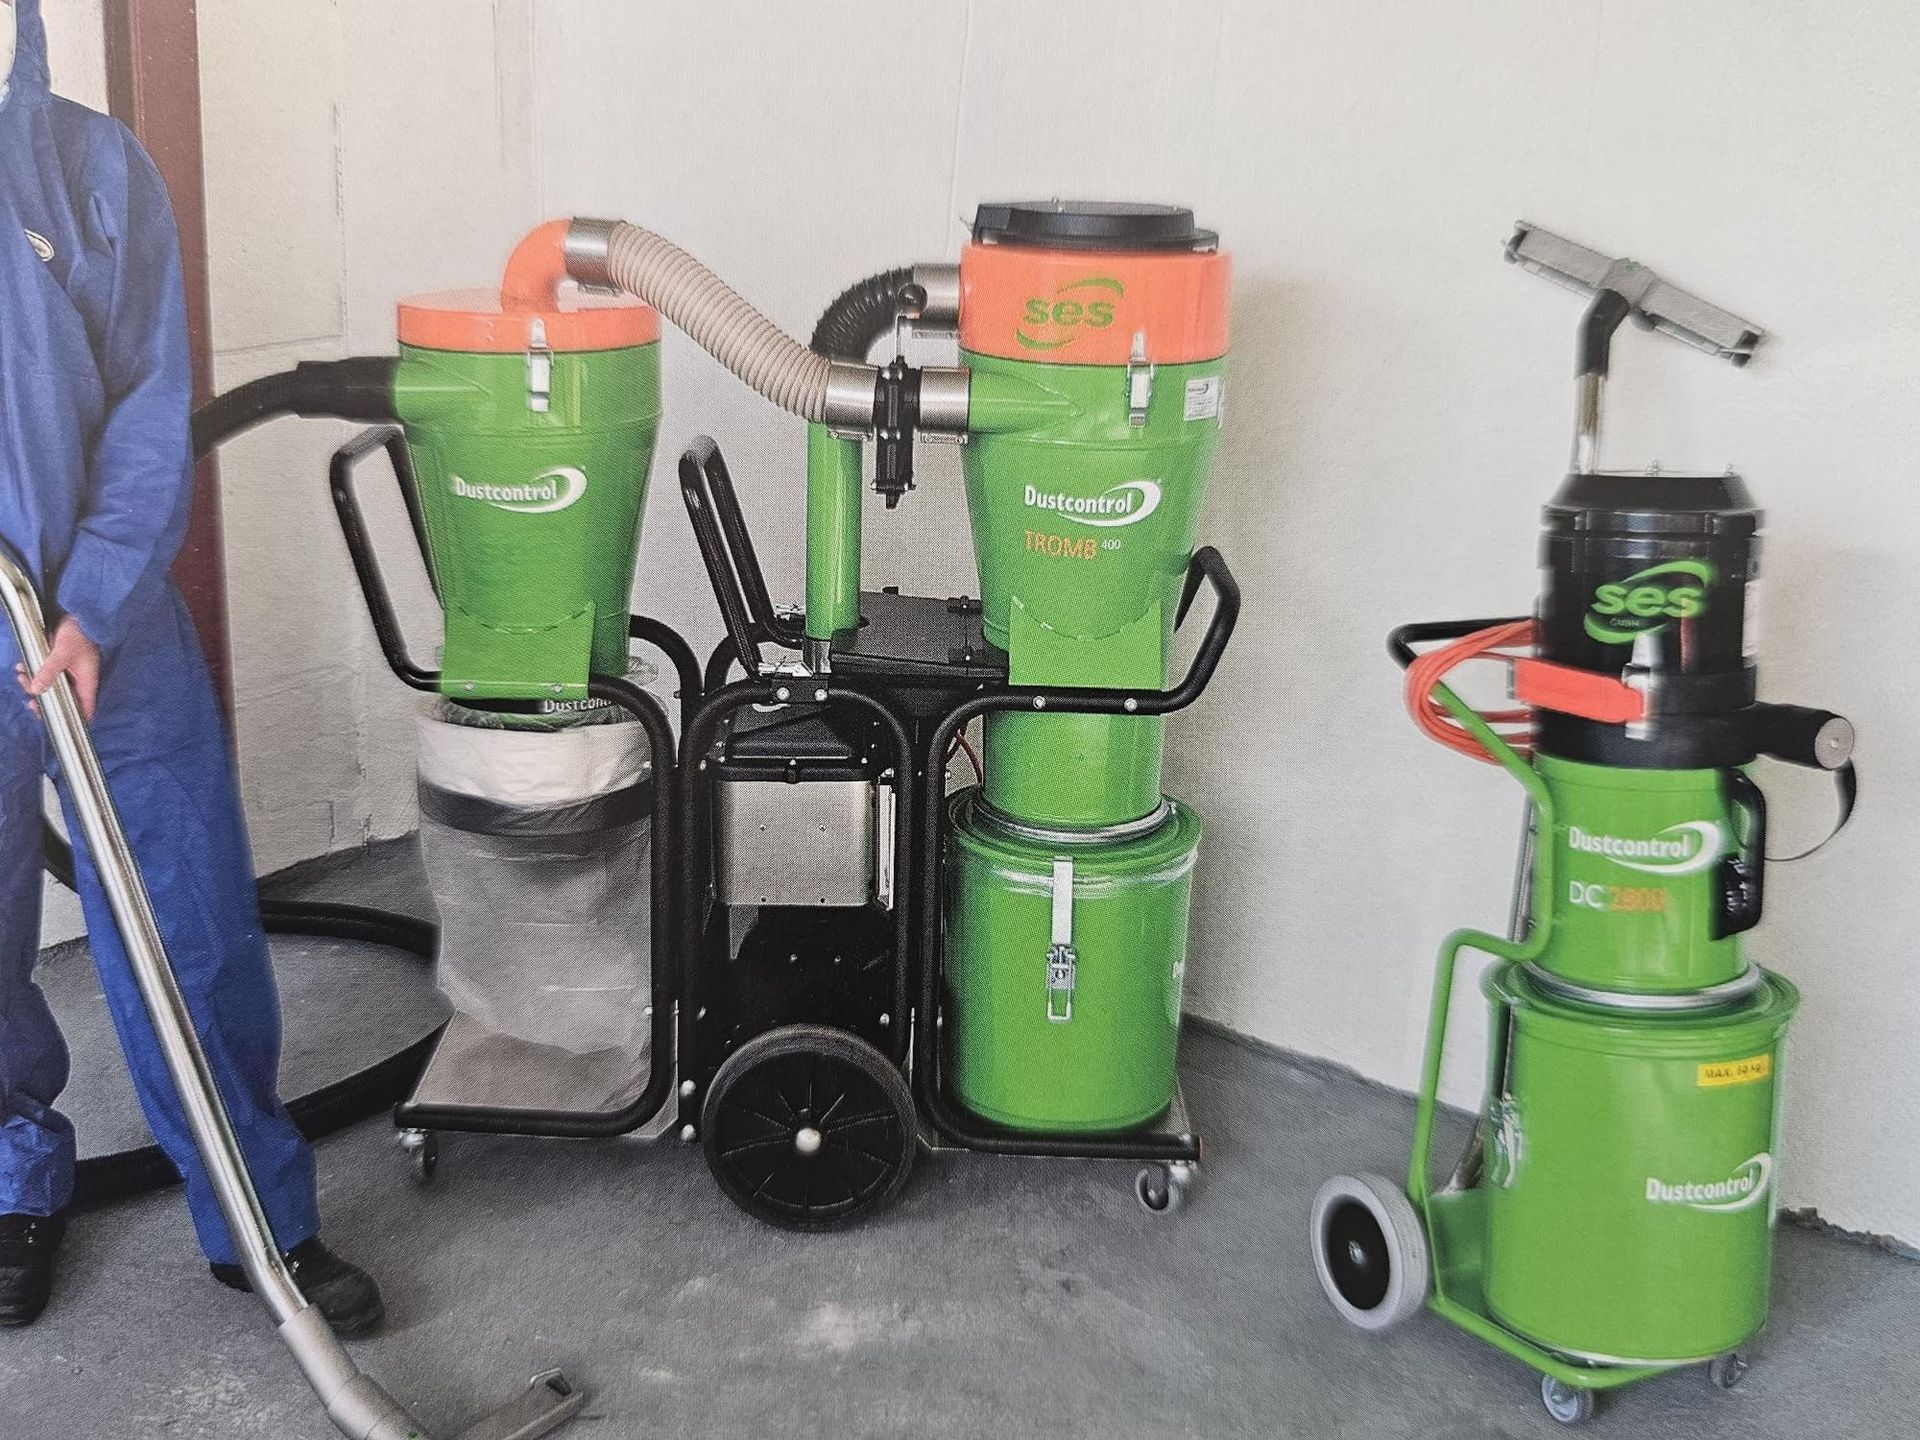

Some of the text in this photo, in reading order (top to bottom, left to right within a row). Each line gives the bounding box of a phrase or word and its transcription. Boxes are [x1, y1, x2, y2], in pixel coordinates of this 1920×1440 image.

[1024, 298, 1114, 328] ses
[453, 476, 557, 500] Dustcontrol
[1024, 484, 1132, 513] Dustcontrol
[1025, 530, 1121, 560] TROMB 400
[1591, 585, 1702, 618] ses
[1569, 826, 1690, 857] Dustcontrol
[1569, 880, 1604, 908] DC
[1646, 1167, 1752, 1201] Dustcontrol
